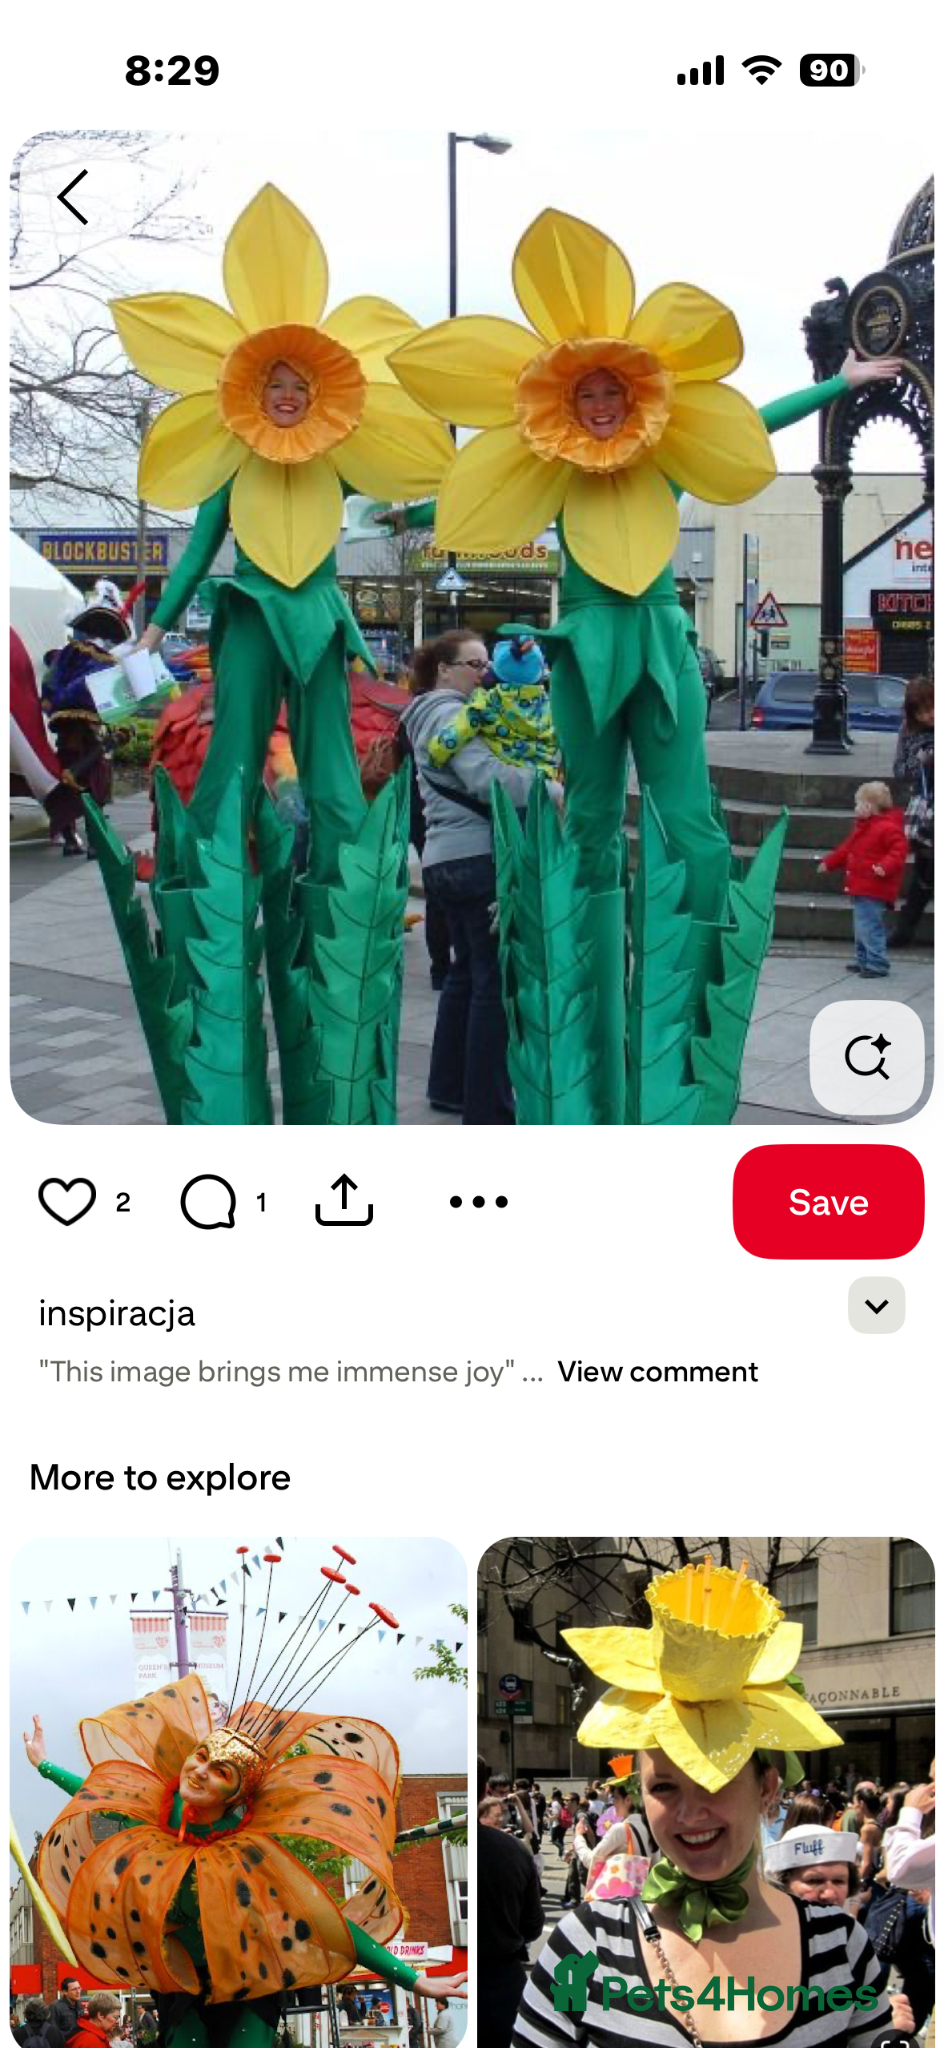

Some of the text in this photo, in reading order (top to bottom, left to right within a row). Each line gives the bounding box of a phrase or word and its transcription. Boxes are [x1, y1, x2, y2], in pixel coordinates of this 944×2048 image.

[125, 54, 220, 87] 8:29
[809, 59, 849, 82] 90
[116, 1191, 131, 1213] 2
[256, 1192, 265, 1213] 1
[789, 1188, 869, 1216] Save
[40, 1298, 196, 1333] inspiracja
[39, 1359, 103, 1383] "This
[110, 1360, 191, 1388] image
[199, 1359, 281, 1388] brings
[288, 1365, 329, 1383] me
[337, 1360, 458, 1383] immense
[464, 1359, 515, 1388] joy"
[557, 1359, 759, 1383] View comment
[30, 1462, 291, 1497] More to explore
[794, 1838, 826, 1857] Fluff
[400, 1945, 425, 1955] DRINKS
